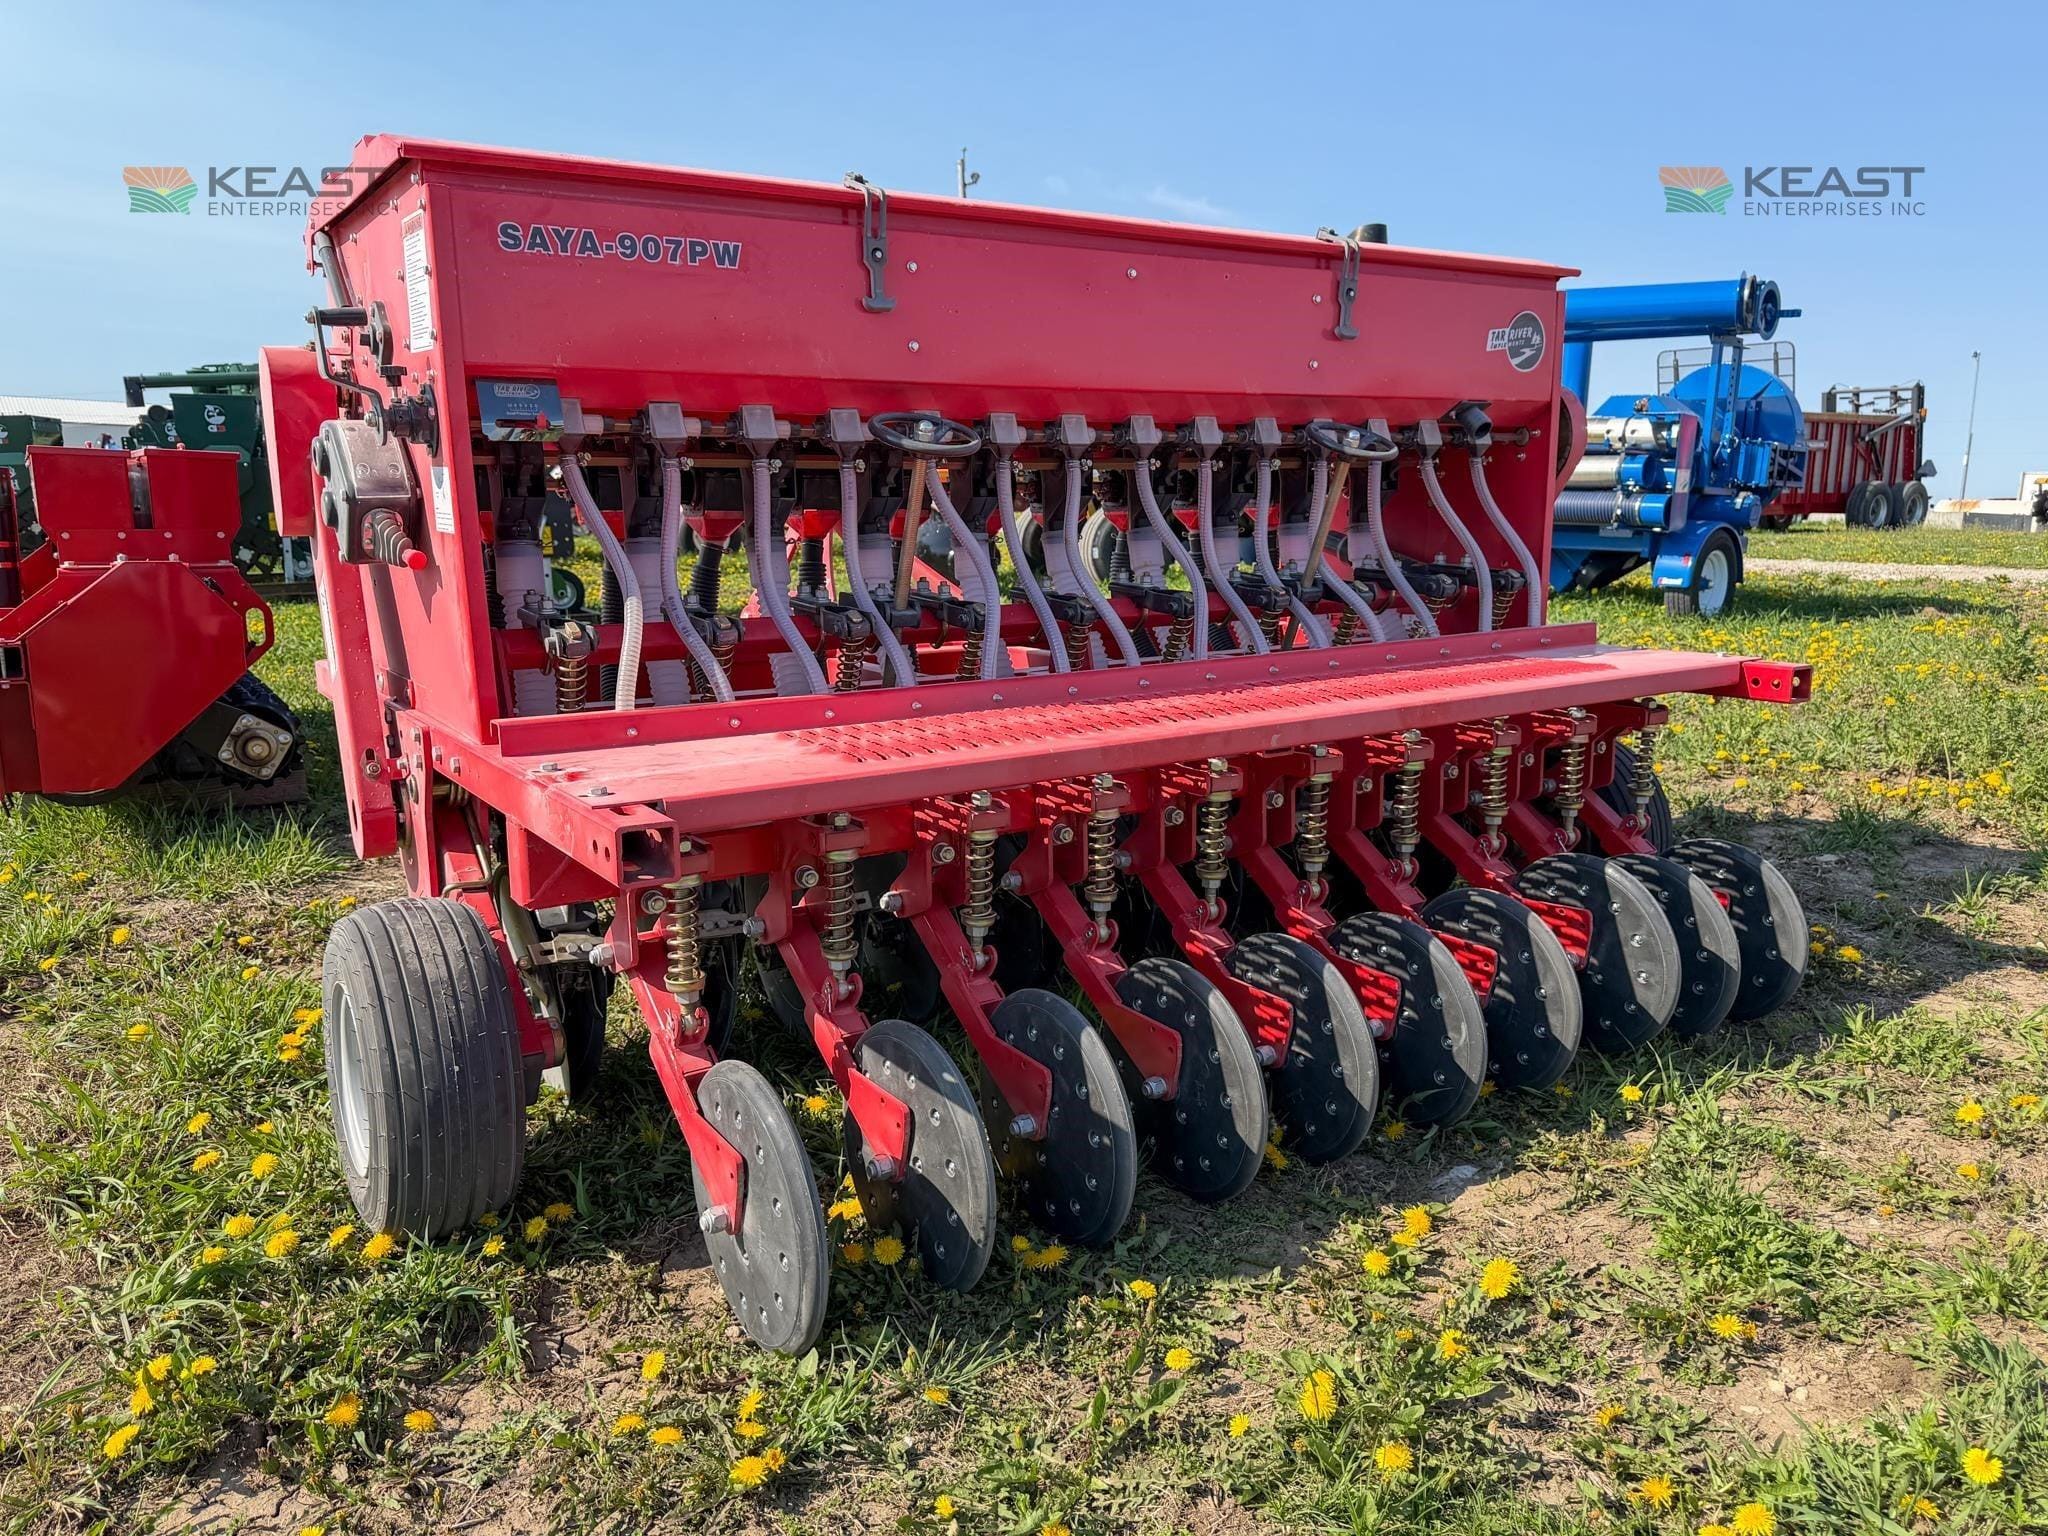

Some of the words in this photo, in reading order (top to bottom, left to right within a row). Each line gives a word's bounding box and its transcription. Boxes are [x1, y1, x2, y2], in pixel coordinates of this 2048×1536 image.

[497, 222, 742, 269] SAYA-907PW
[1491, 329, 1506, 342] TAR
[1509, 326, 1533, 341] RIVER
